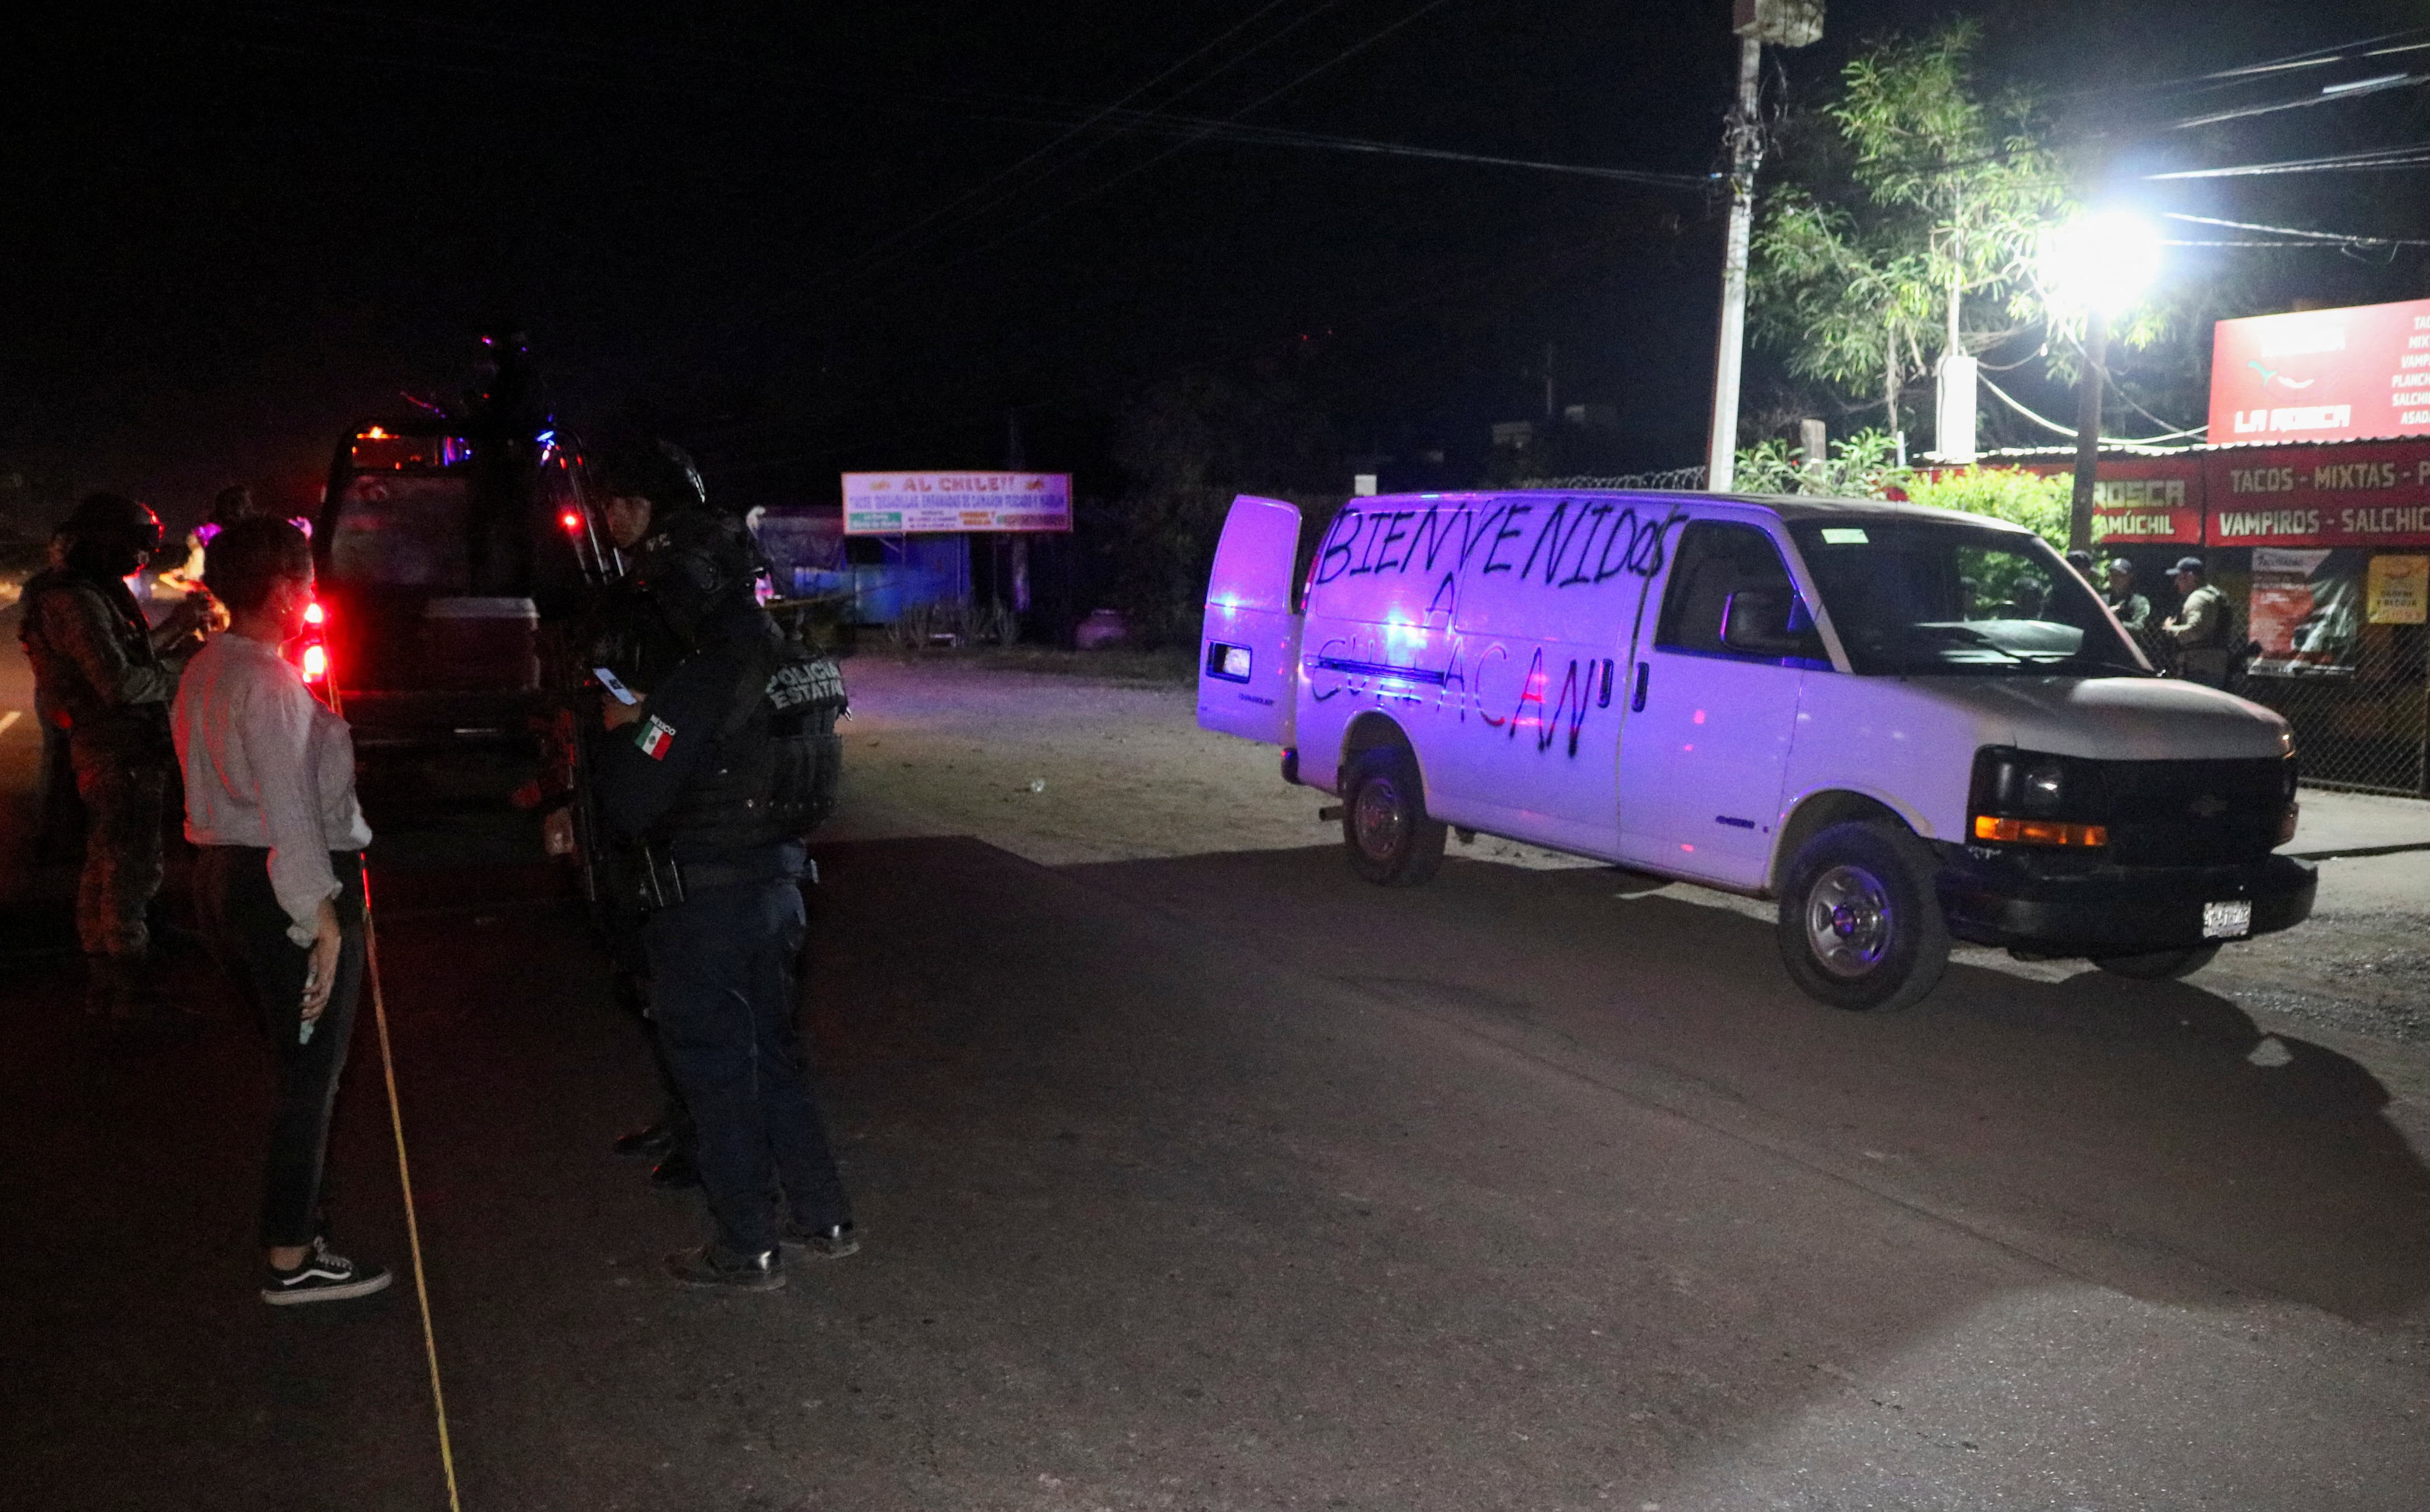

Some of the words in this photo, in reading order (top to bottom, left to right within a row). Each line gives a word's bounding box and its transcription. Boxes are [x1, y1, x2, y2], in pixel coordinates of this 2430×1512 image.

[2235, 409, 2267, 433] LA
[2270, 404, 2351, 432] ROCA
[902, 477, 932, 492] AL
[2230, 467, 2294, 493] TACOS
[2314, 462, 2395, 490] MIXTAS
[2219, 509, 2320, 537] VAMPIROS
[1316, 499, 1690, 588] BIENVENIDOS
[1424, 571, 1455, 632] A
